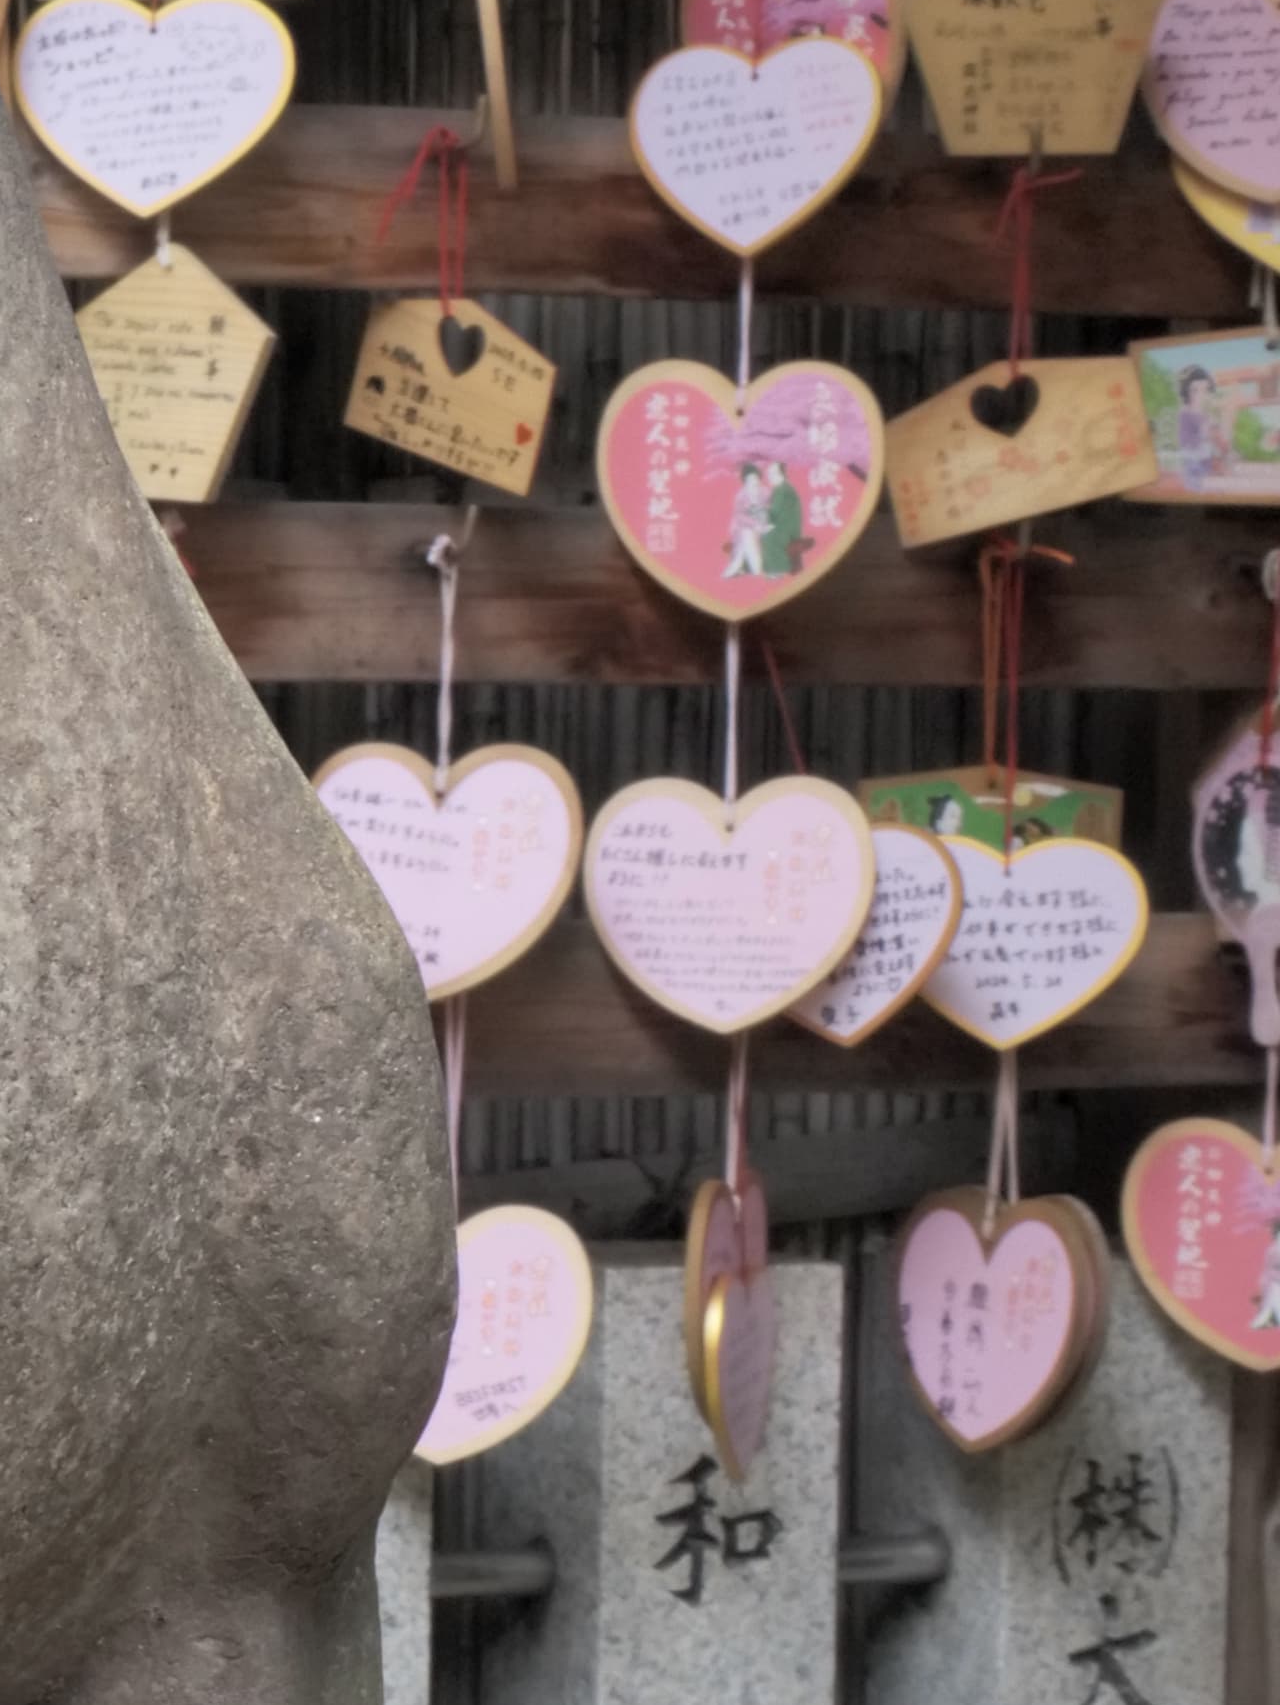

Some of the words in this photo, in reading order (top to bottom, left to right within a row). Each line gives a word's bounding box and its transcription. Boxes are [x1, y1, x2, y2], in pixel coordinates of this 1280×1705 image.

[646, 391, 679, 520] 恋人の聖地
[1177, 1145, 1208, 1270] 恋人の聖地
